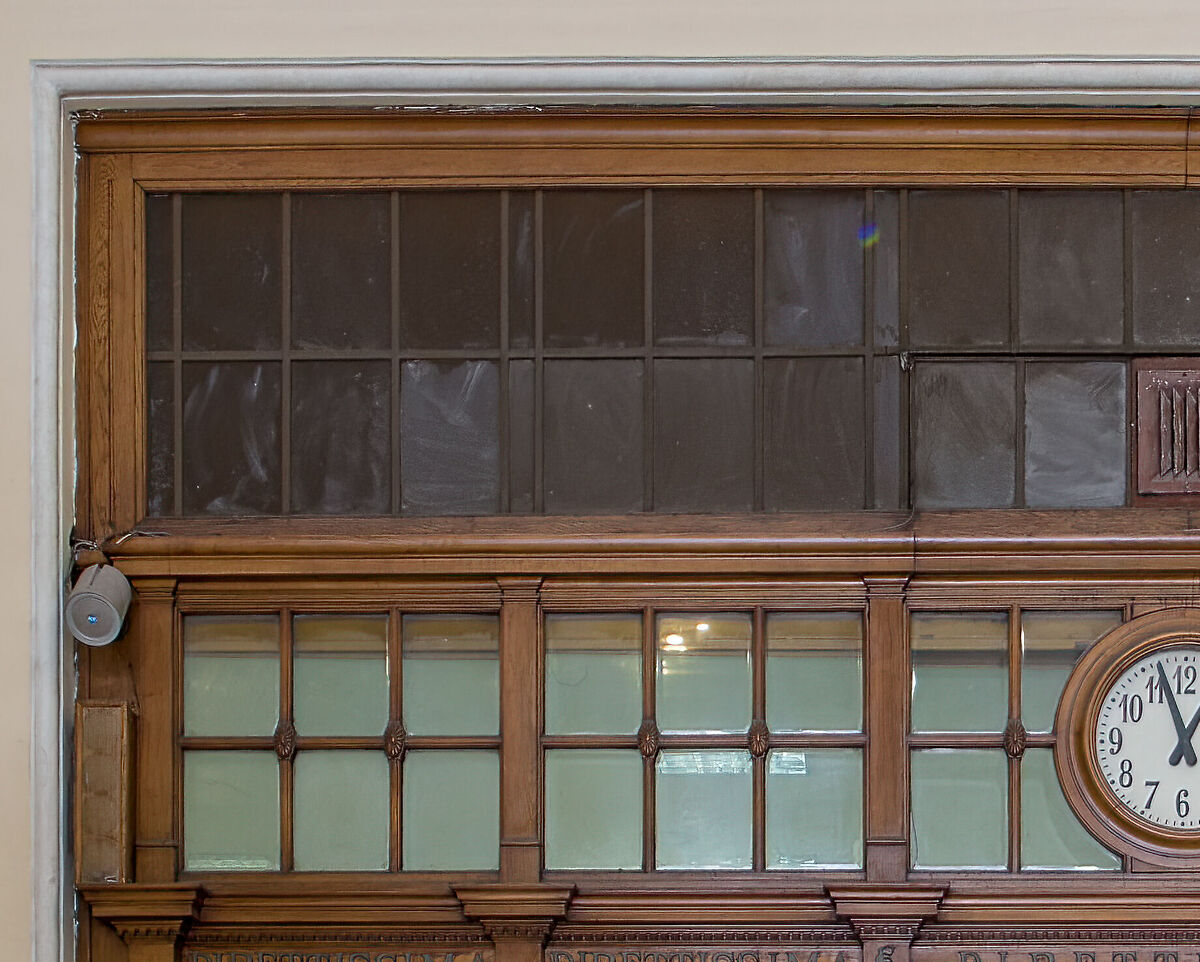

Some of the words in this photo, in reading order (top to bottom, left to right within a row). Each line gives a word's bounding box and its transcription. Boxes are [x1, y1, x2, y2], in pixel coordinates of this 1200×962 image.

[1146, 676, 1165, 704] 11
[1173, 665, 1197, 695] 12
[1119, 694, 1143, 723] 10
[1108, 727, 1122, 755] 9
[1119, 759, 1133, 788] 8
[1145, 781, 1160, 809] 7
[1176, 789, 1190, 818] 6
